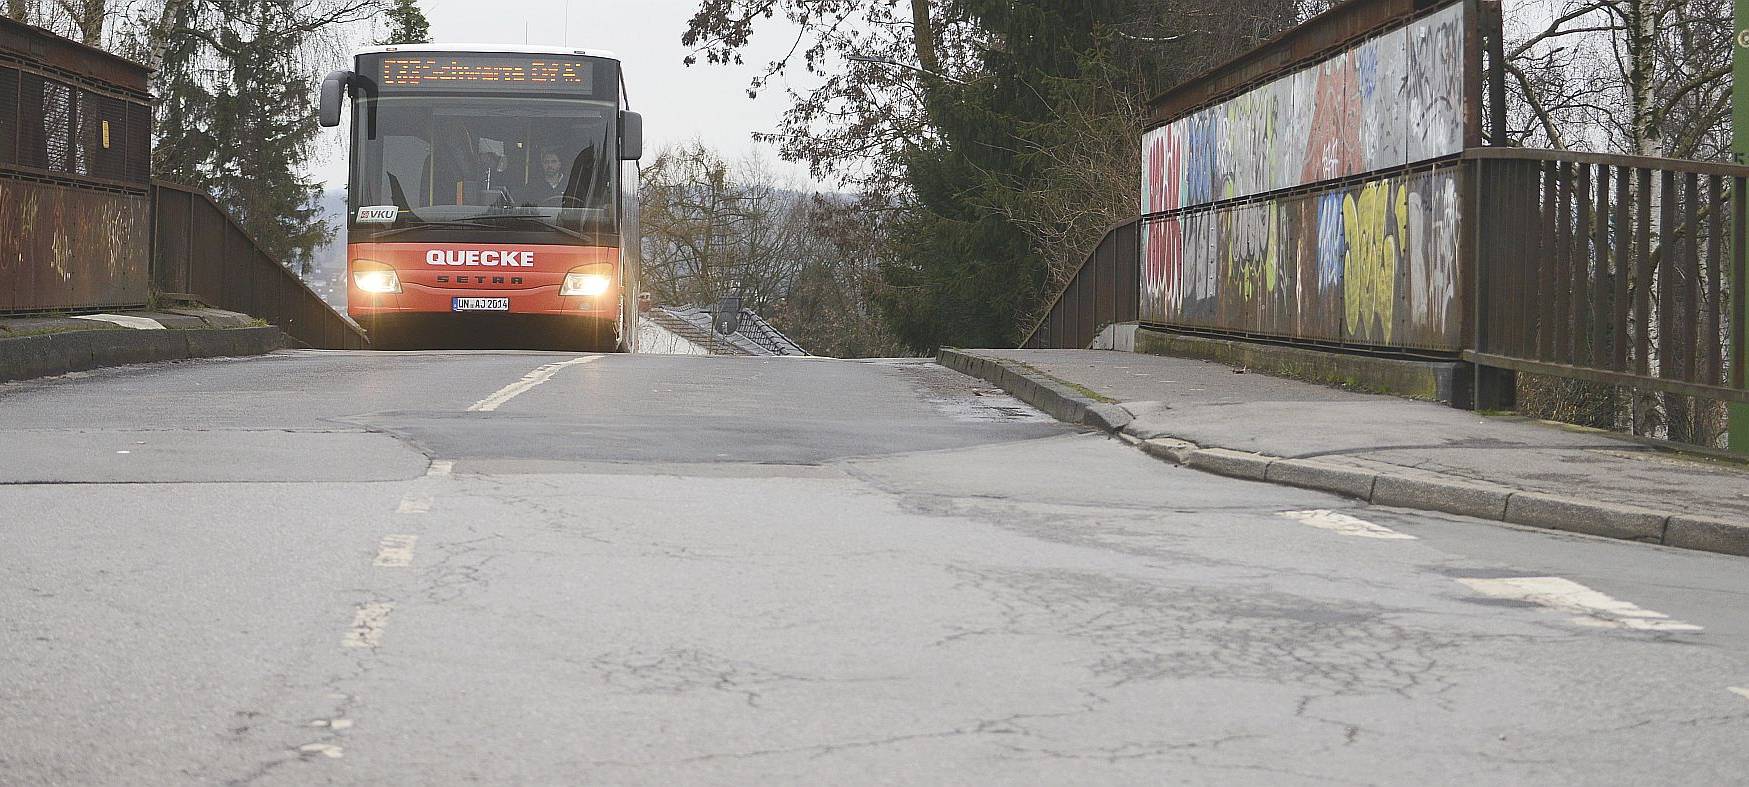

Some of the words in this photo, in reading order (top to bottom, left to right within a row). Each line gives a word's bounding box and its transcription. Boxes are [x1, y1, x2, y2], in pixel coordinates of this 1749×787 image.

[370, 210, 394, 219] VKU
[426, 249, 534, 267] QUECKE
[437, 275, 523, 285] SETRA
[487, 299, 508, 309] 2014
